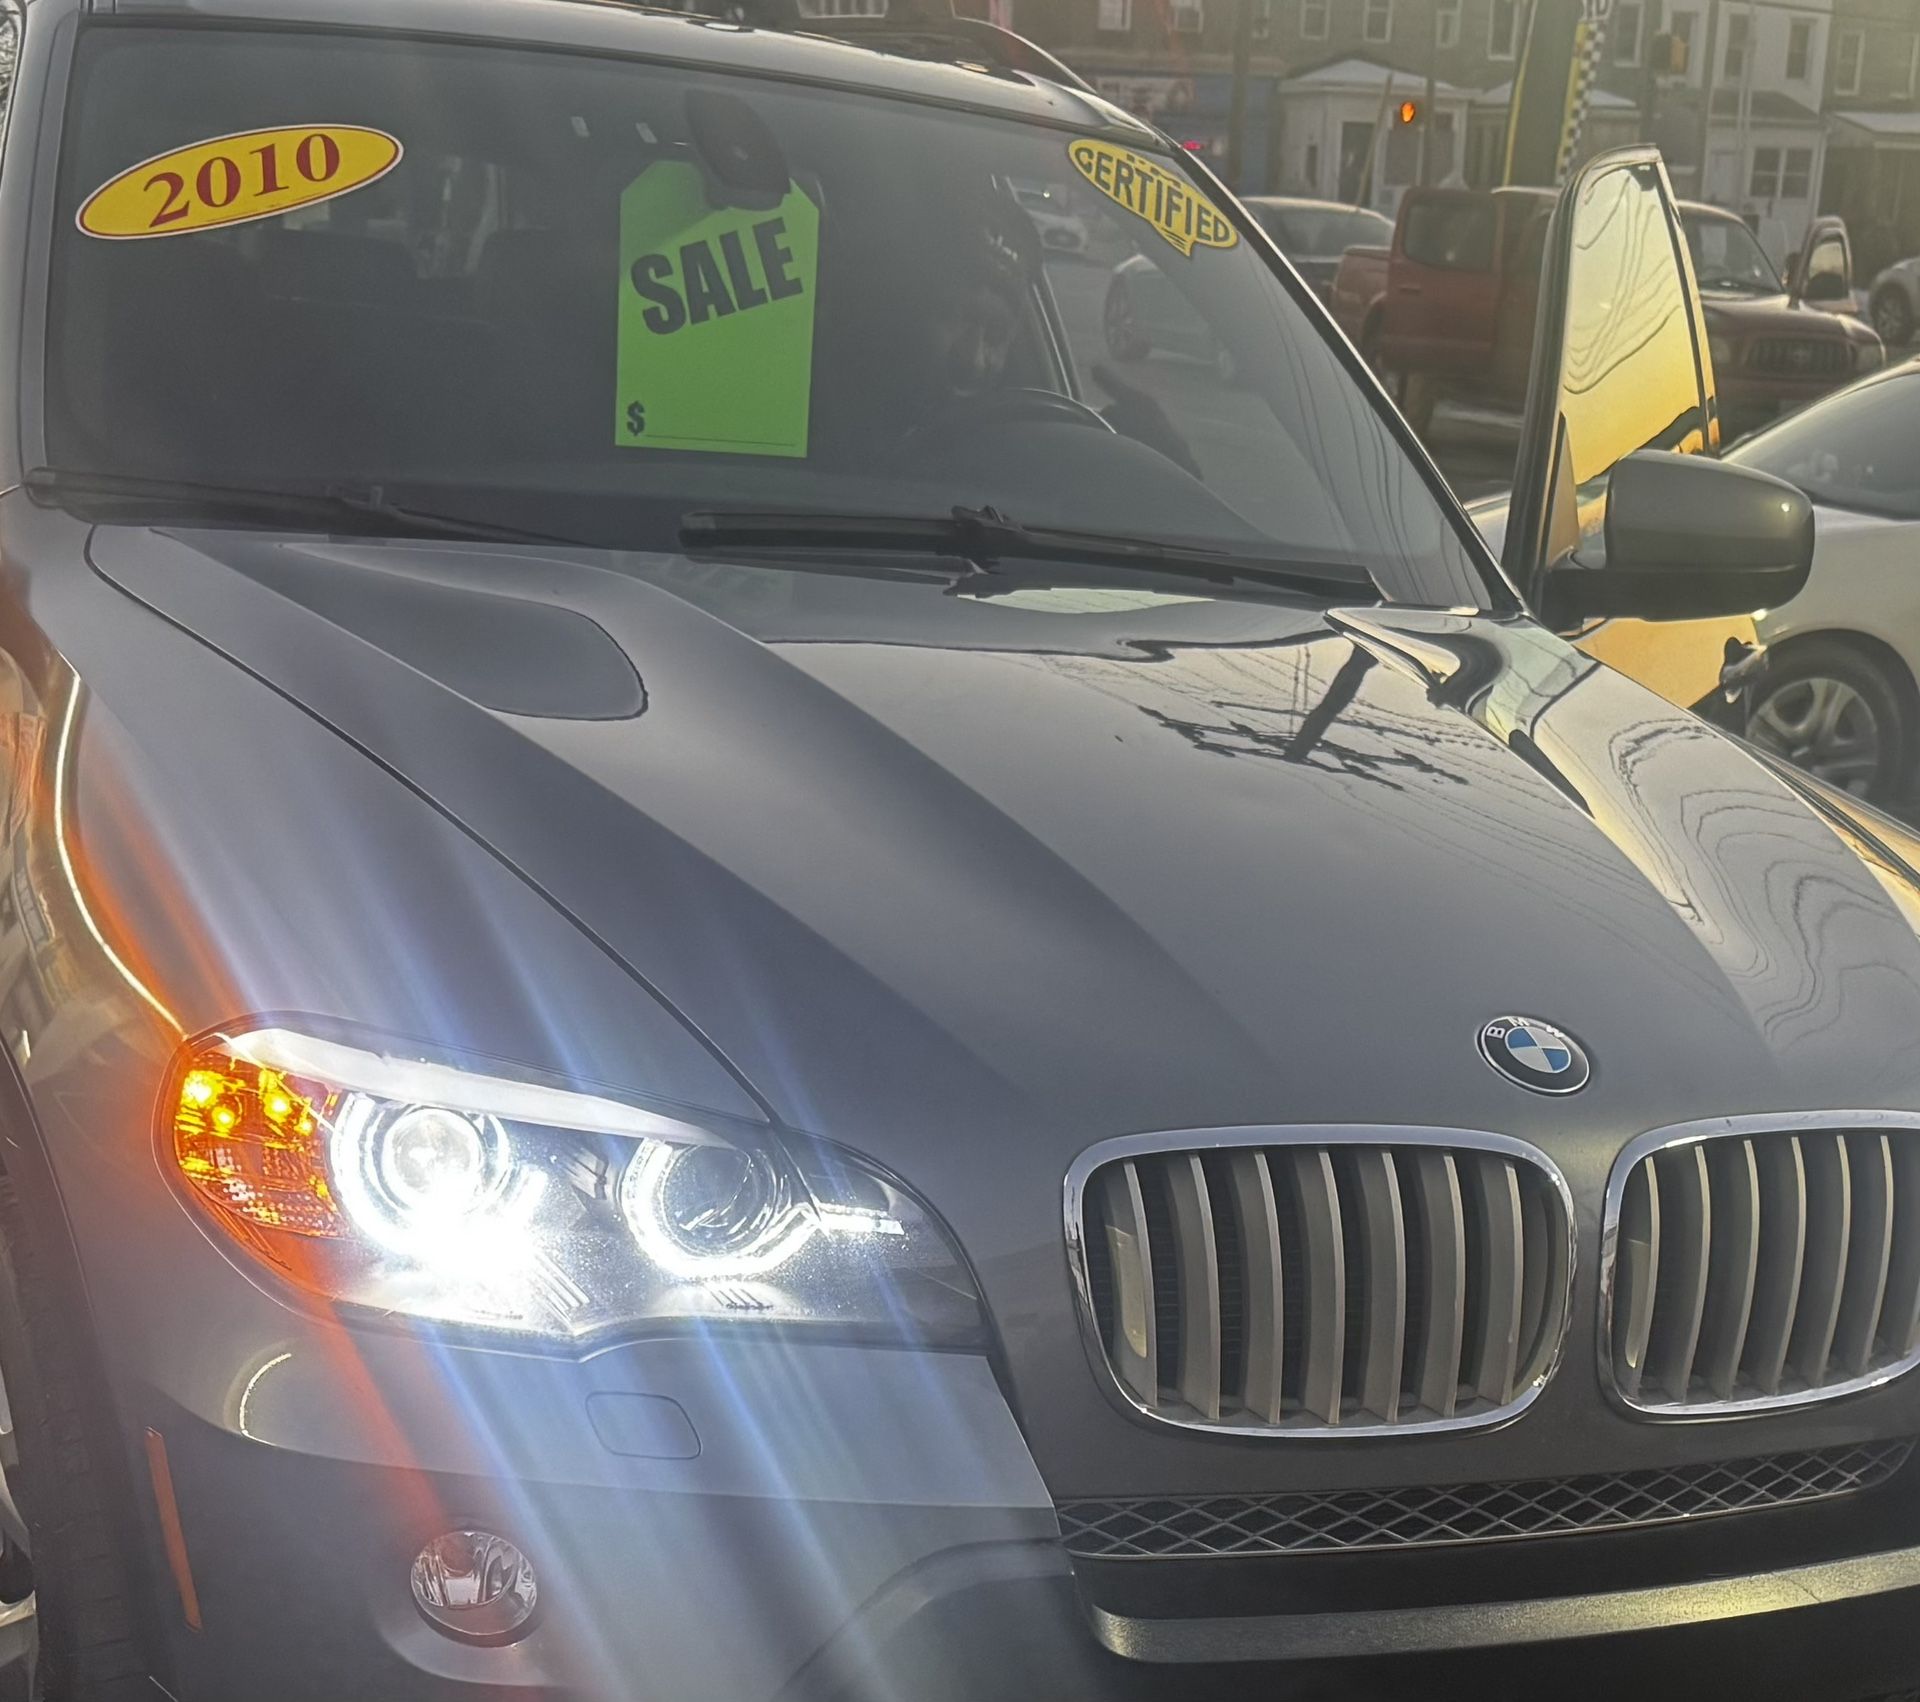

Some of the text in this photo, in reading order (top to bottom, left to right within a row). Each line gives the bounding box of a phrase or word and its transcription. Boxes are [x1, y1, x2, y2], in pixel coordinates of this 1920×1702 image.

[143, 133, 340, 228] 2010
[1074, 147, 1230, 242] CERTIFIED
[631, 217, 803, 335] SALE
[626, 401, 645, 436] $
[1486, 1016, 1565, 1038] BMW
